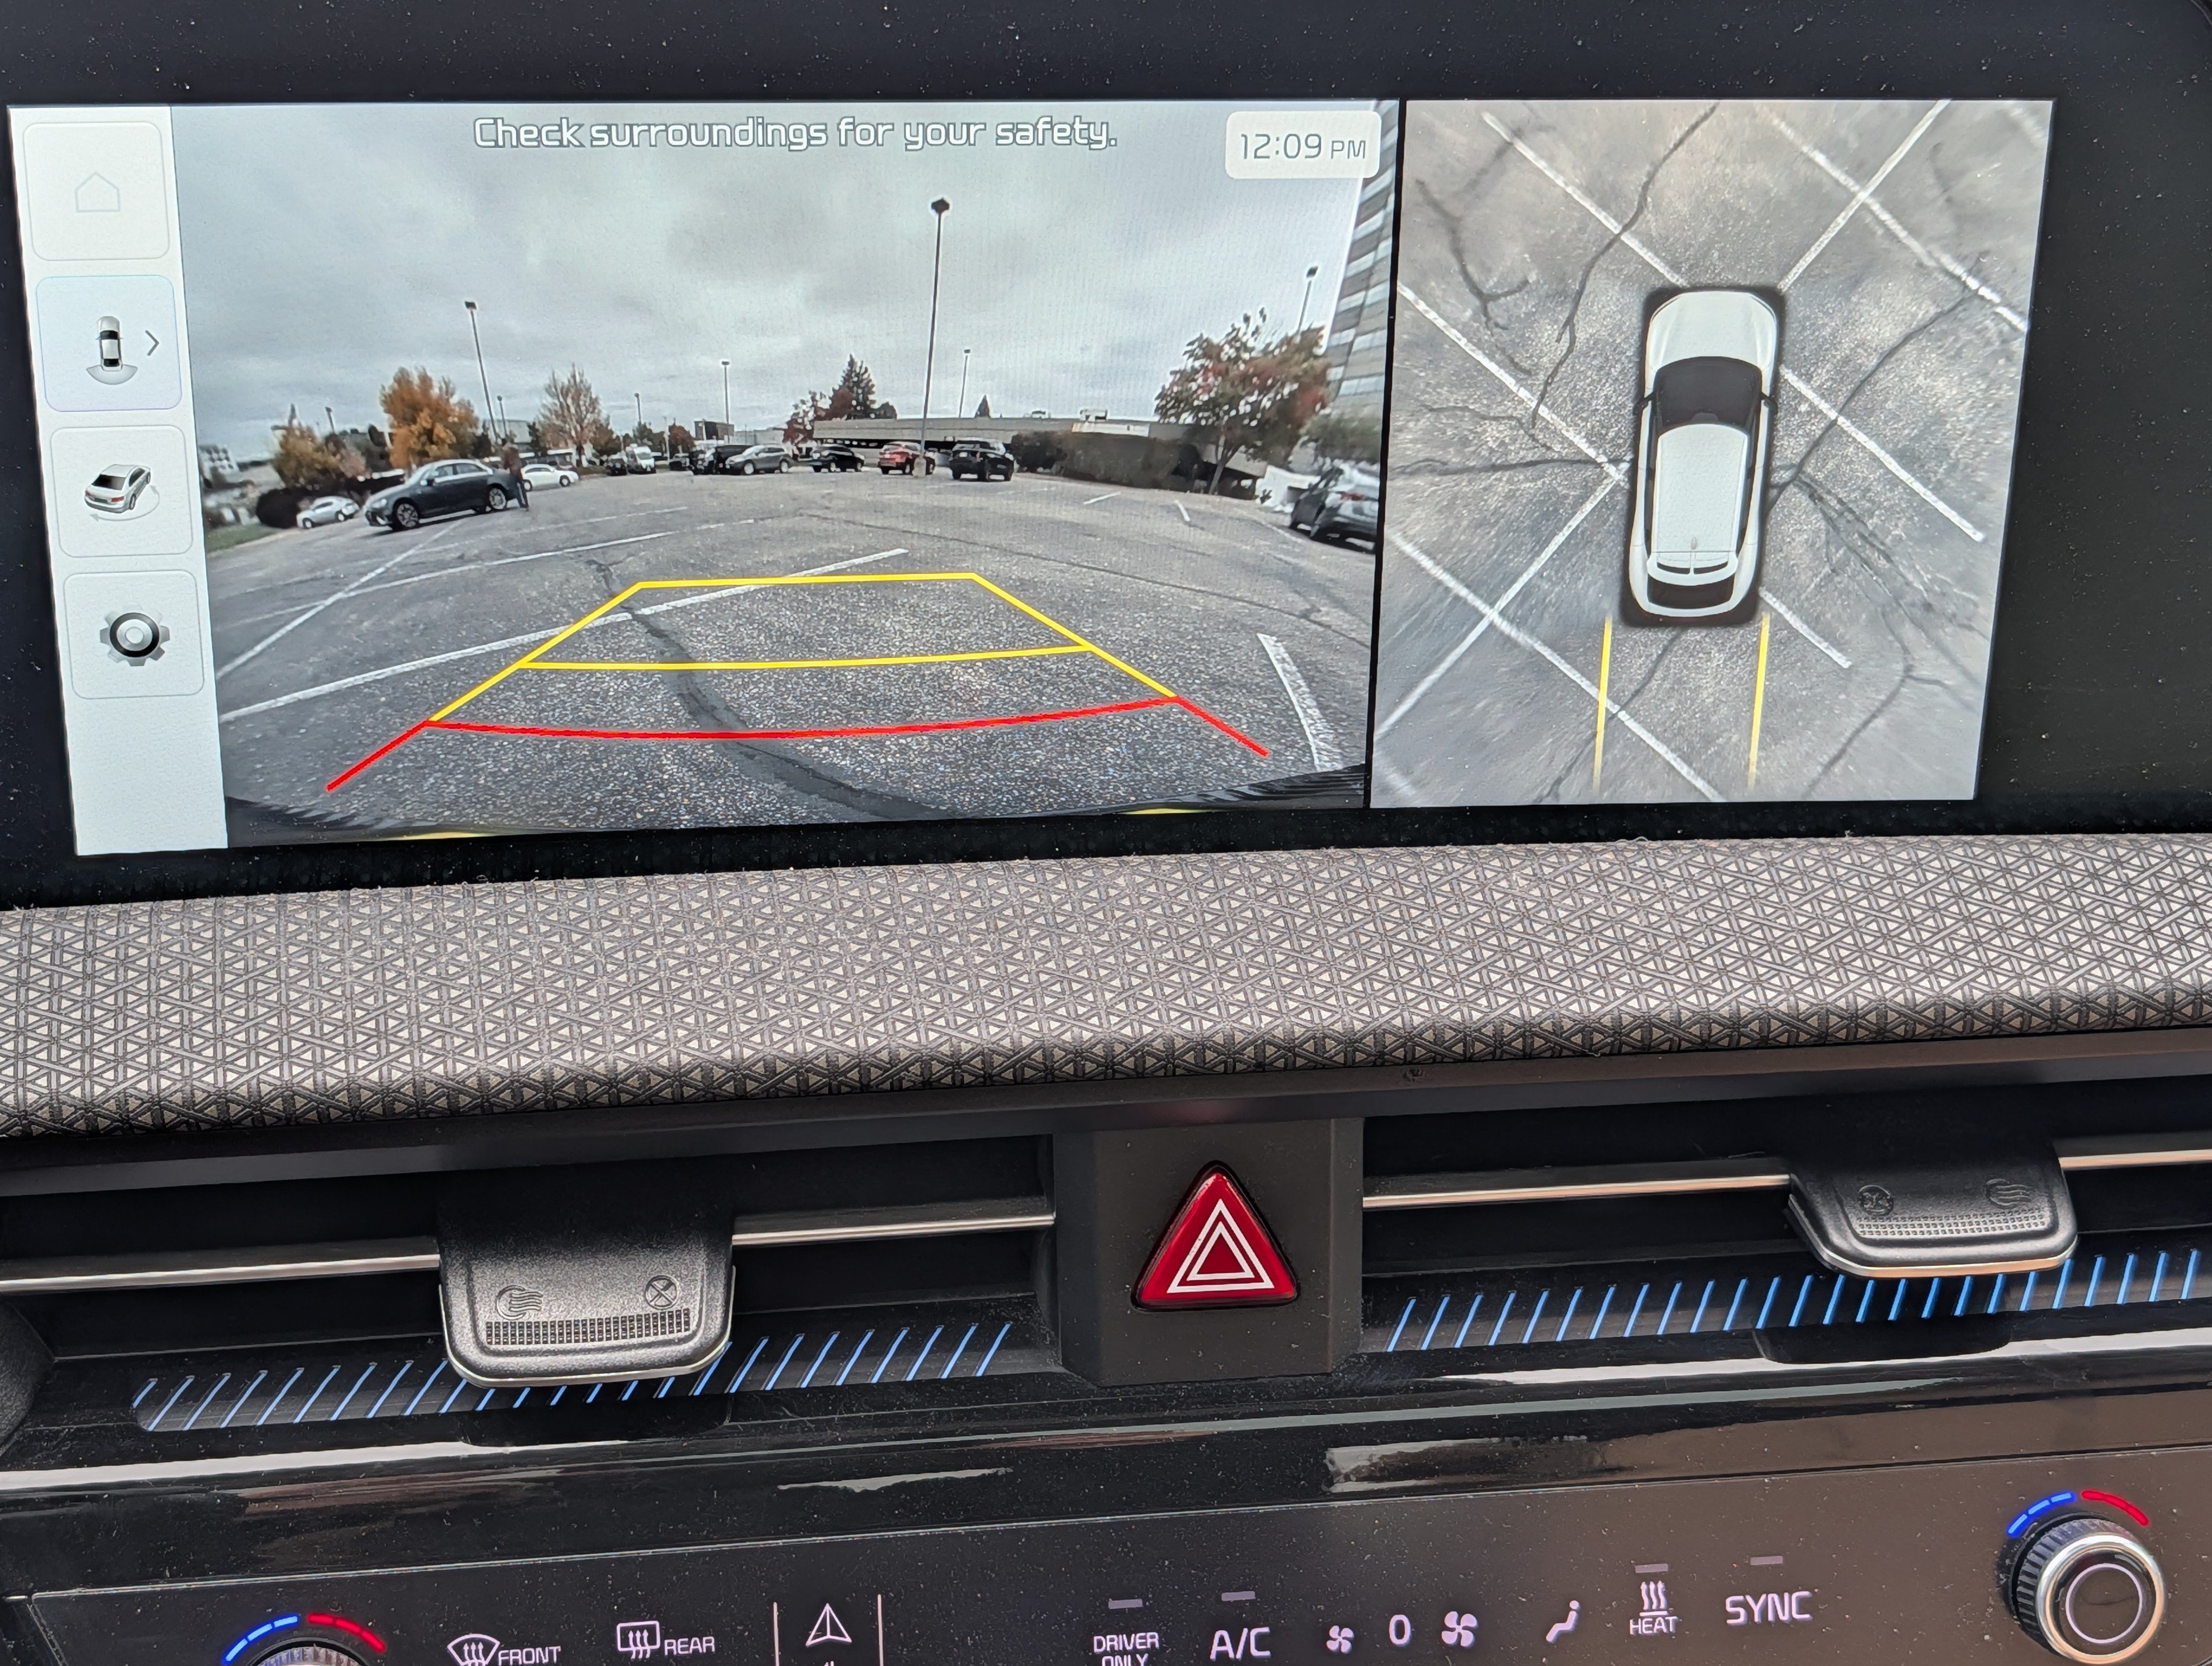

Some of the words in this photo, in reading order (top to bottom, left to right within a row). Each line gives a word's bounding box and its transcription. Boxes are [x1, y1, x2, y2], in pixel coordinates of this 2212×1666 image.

[474, 117, 585, 148] Check
[590, 116, 828, 151] surroundings
[837, 116, 894, 147] for
[904, 122, 987, 151] your
[996, 116, 1117, 151] safety.
[1240, 133, 1322, 159] 12:09
[1330, 139, 1366, 159] PM
[1725, 1591, 1812, 1626] SYNC
[1389, 1614, 1411, 1645] 0
[1630, 1616, 1678, 1635] HEAT
[498, 1645, 561, 1666] FRONT
[664, 1636, 715, 1656] REAR
[1094, 1632, 1159, 1654] DRIVER
[1210, 1627, 1271, 1661] A/C
